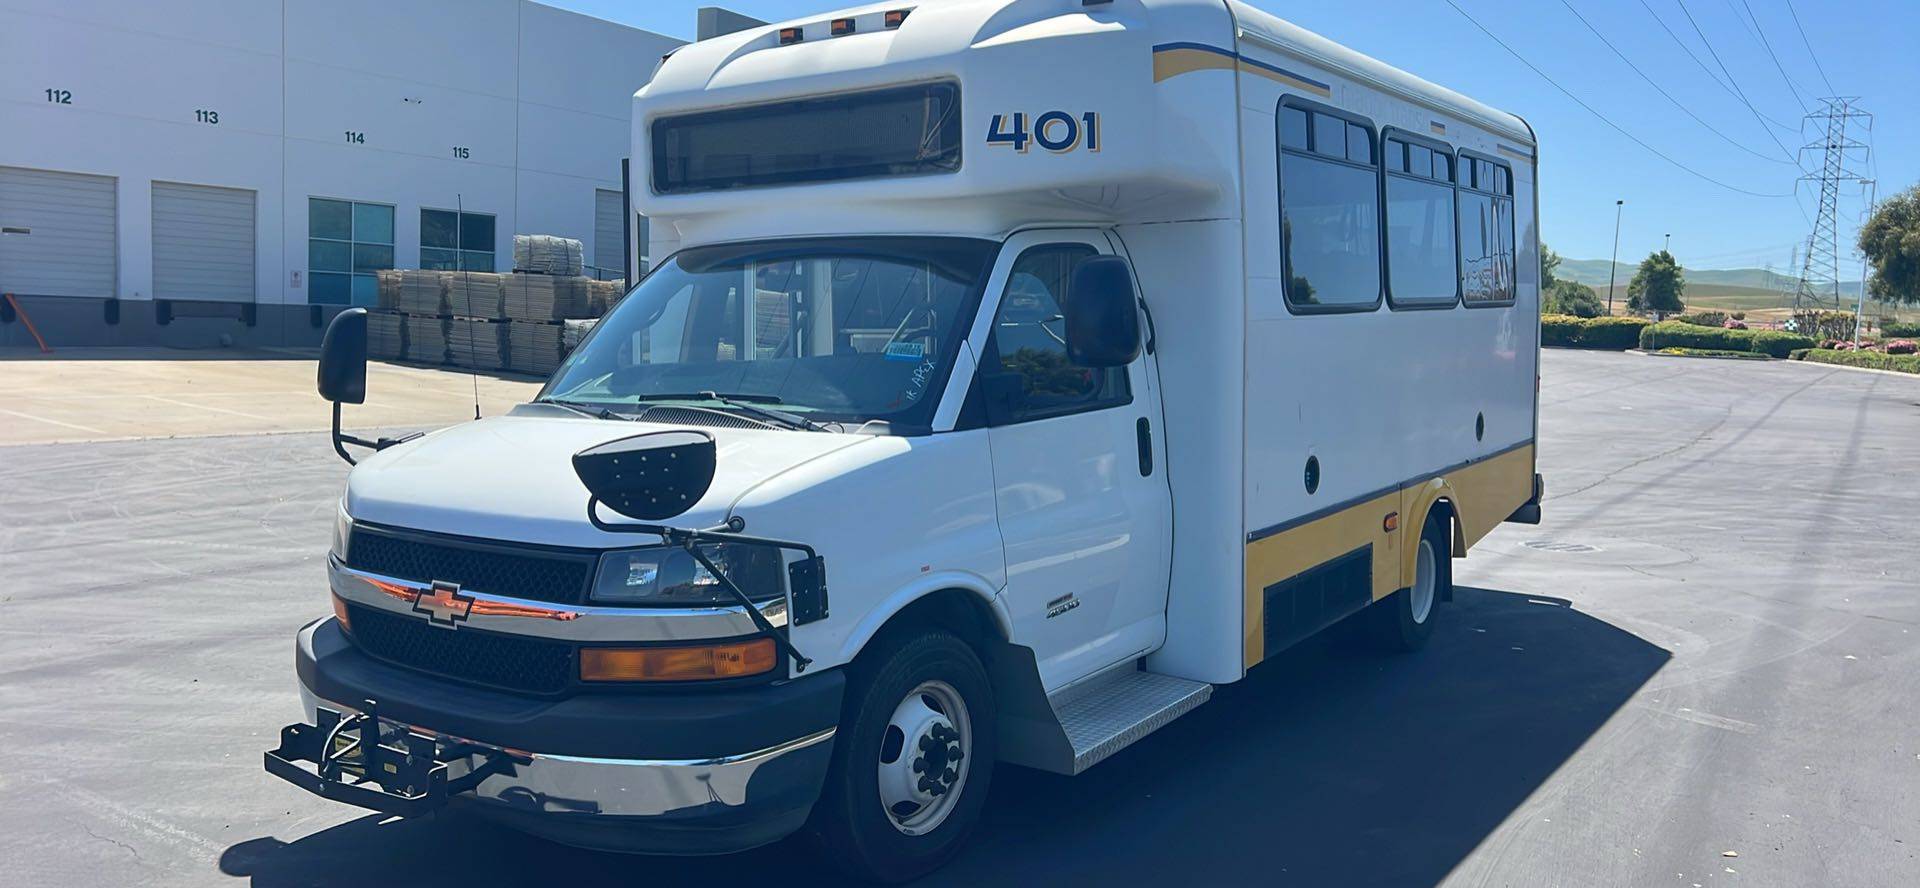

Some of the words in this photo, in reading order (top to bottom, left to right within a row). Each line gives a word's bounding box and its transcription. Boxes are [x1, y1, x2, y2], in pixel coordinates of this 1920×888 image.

[45, 88, 72, 104] 112
[195, 109, 219, 124] 113
[344, 130, 365, 144] 114
[986, 110, 1101, 154] 401
[452, 146, 470, 159] 115
